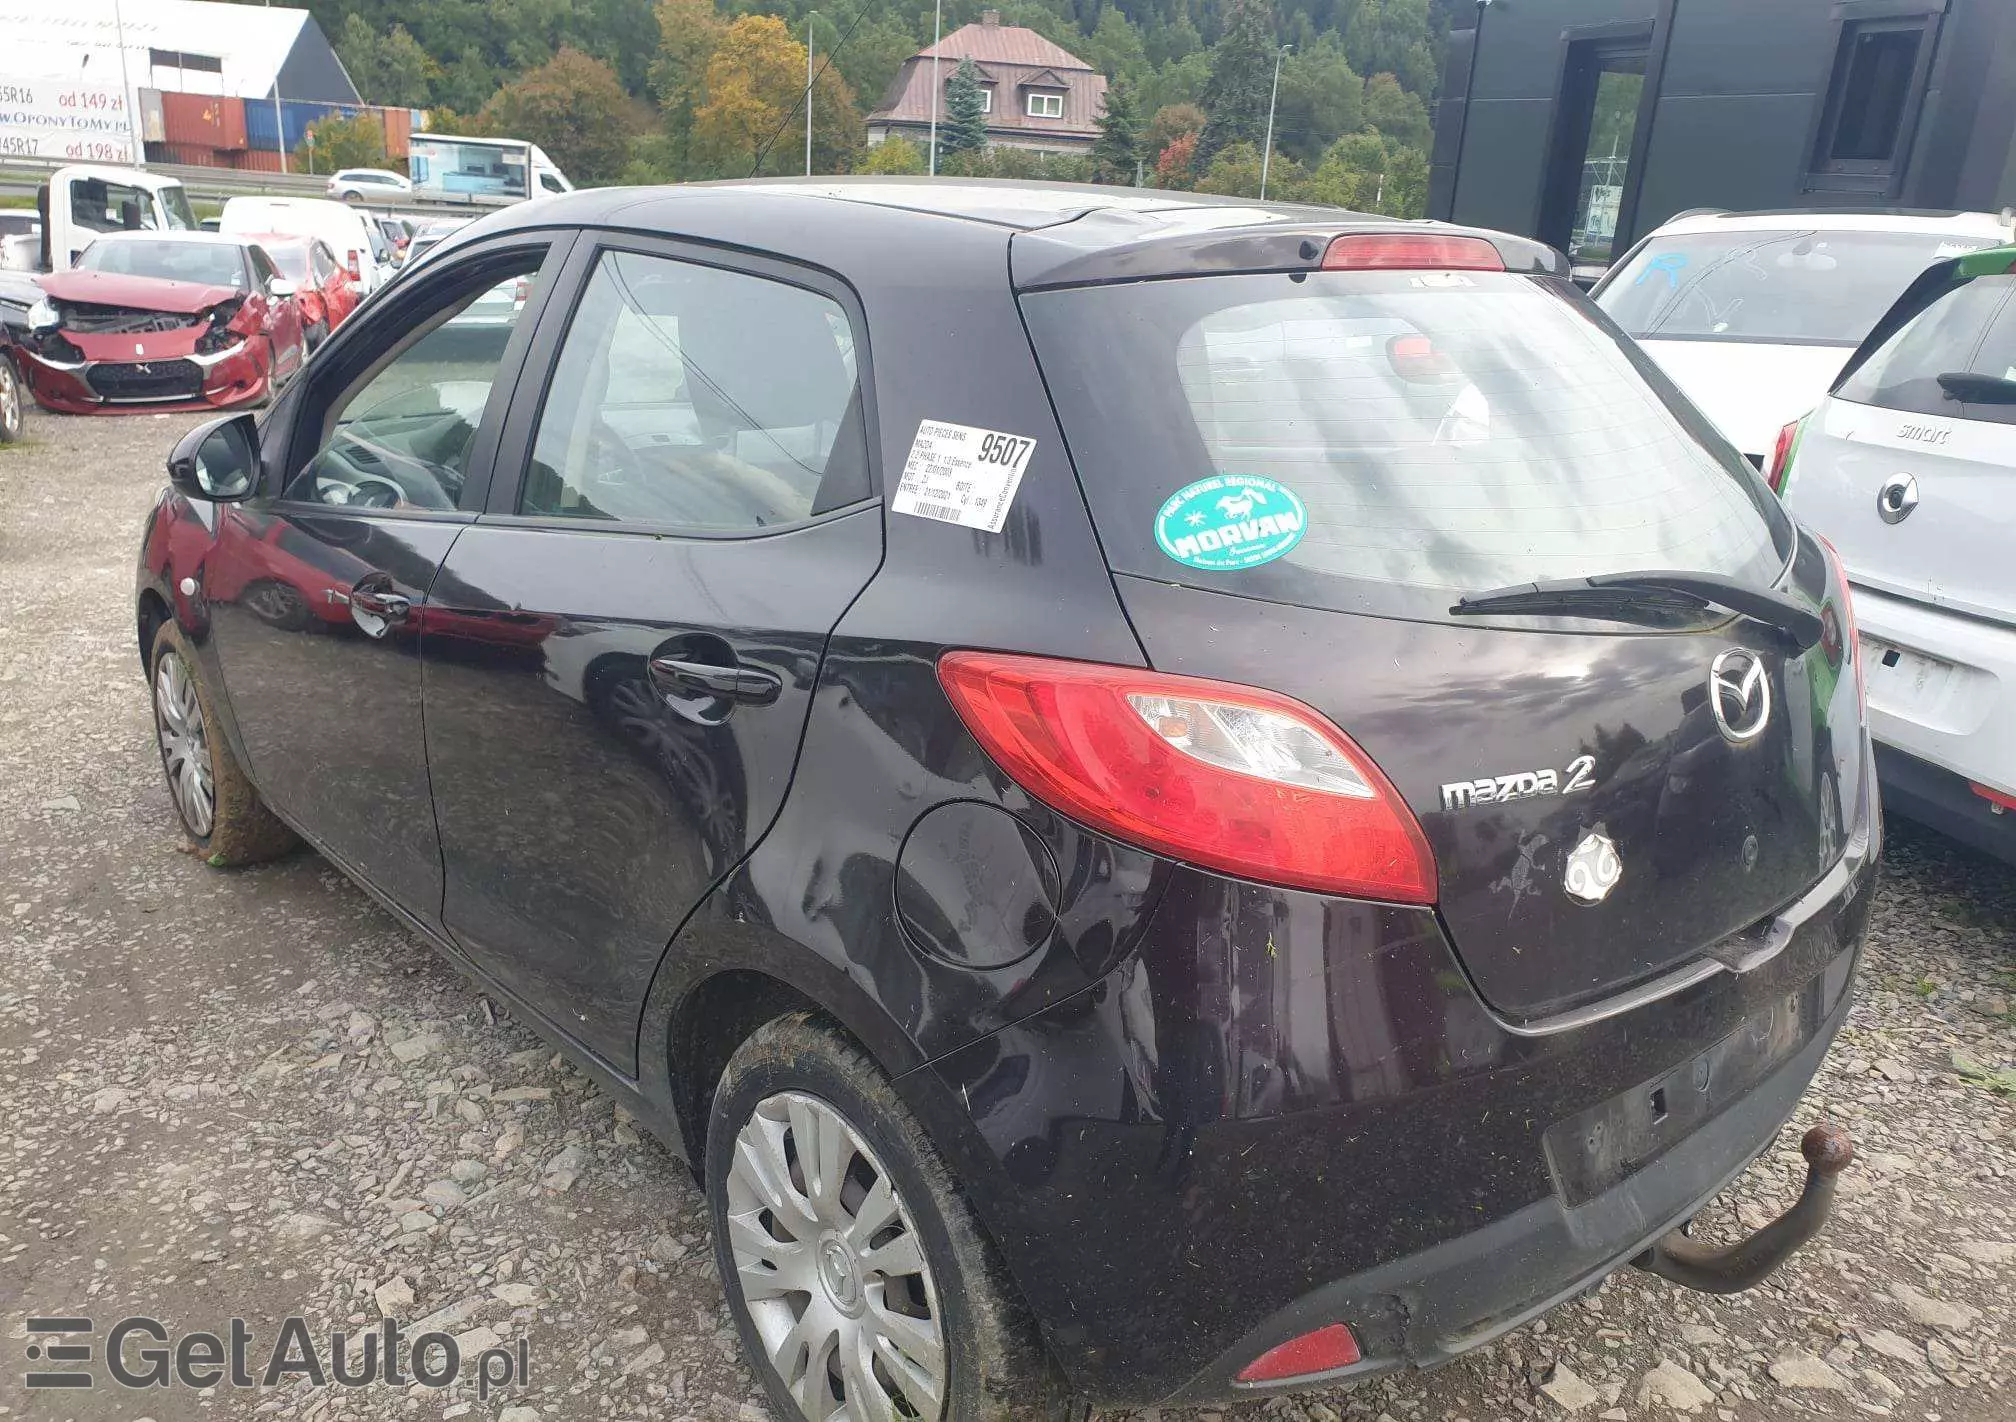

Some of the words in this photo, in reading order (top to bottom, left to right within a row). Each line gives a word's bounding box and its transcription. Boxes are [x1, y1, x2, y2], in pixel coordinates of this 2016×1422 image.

[81, 92, 107, 111] 149
[0, 136, 39, 156] 45R17
[1896, 422, 1953, 445] smart
[978, 433, 1031, 468] 9507
[1174, 511, 1301, 559] MORVAN
[1562, 755, 1597, 794] 2
